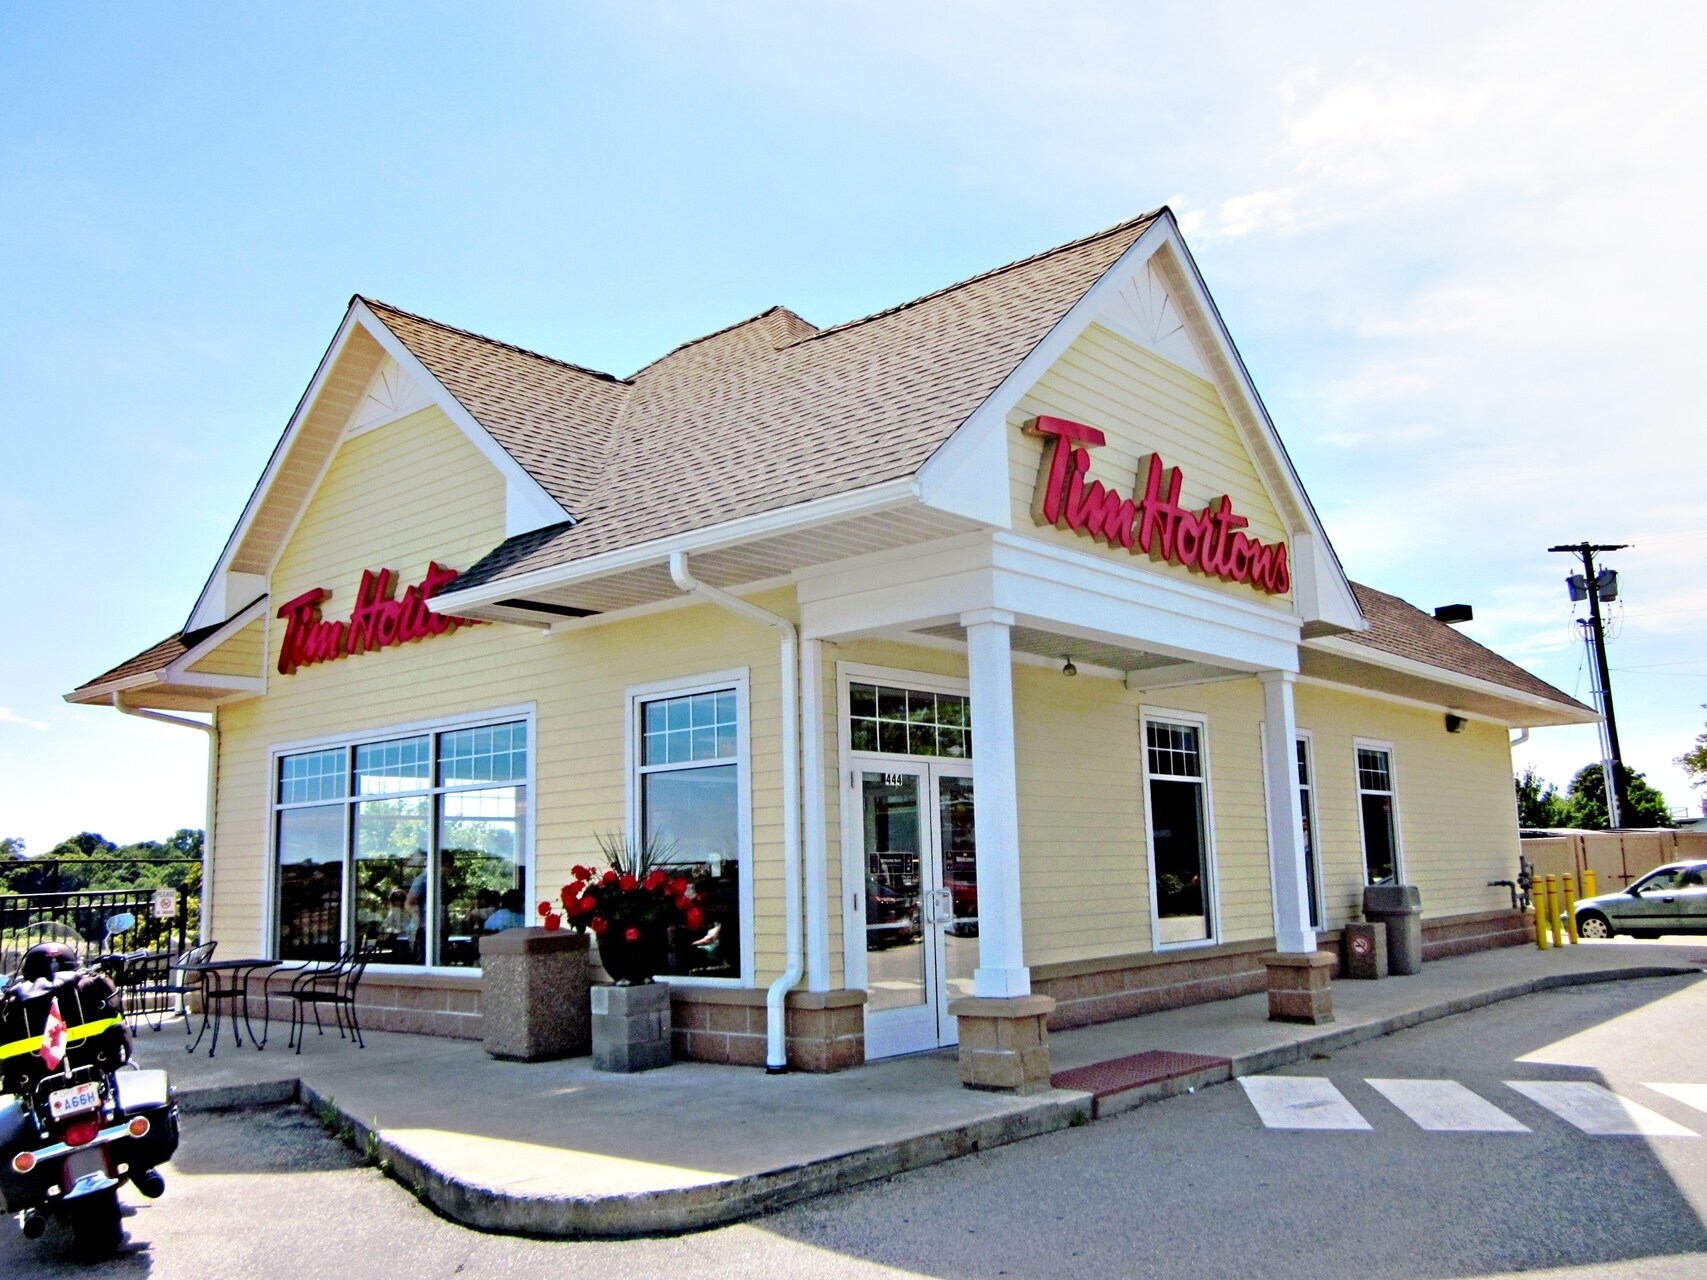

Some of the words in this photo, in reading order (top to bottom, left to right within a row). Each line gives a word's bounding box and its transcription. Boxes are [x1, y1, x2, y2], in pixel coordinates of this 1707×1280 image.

[1026, 414, 1136, 550] Tim
[1136, 451, 1290, 595] Hortons
[276, 586, 346, 675] Tim
[886, 773, 902, 785] 444
[65, 1091, 95, 1110] A66H
